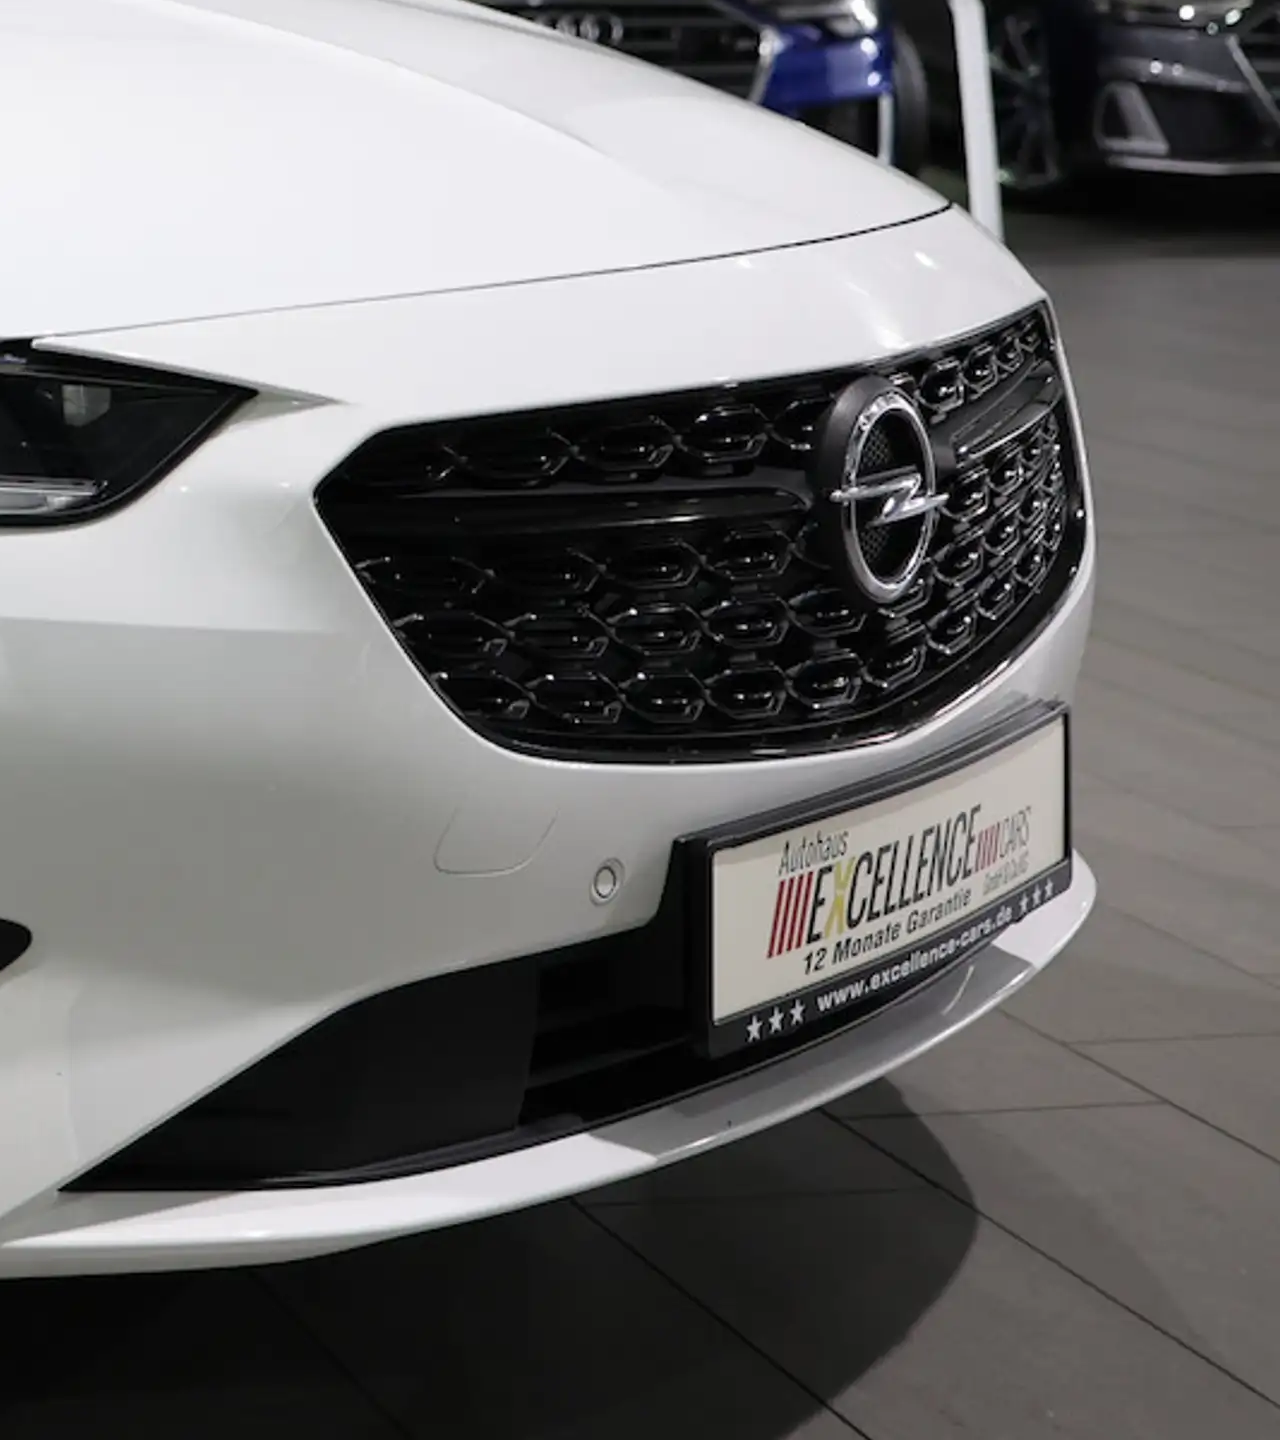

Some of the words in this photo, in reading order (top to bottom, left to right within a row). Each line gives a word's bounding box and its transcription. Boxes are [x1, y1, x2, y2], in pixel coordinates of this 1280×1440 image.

[778, 830, 849, 876] Autohaus
[806, 805, 981, 944] EXCELLENCE
[804, 947, 828, 975] 12
[831, 920, 902, 965] Monate
[905, 888, 972, 935] Garantie
[816, 905, 1013, 1012] www.excellence-cars.de
